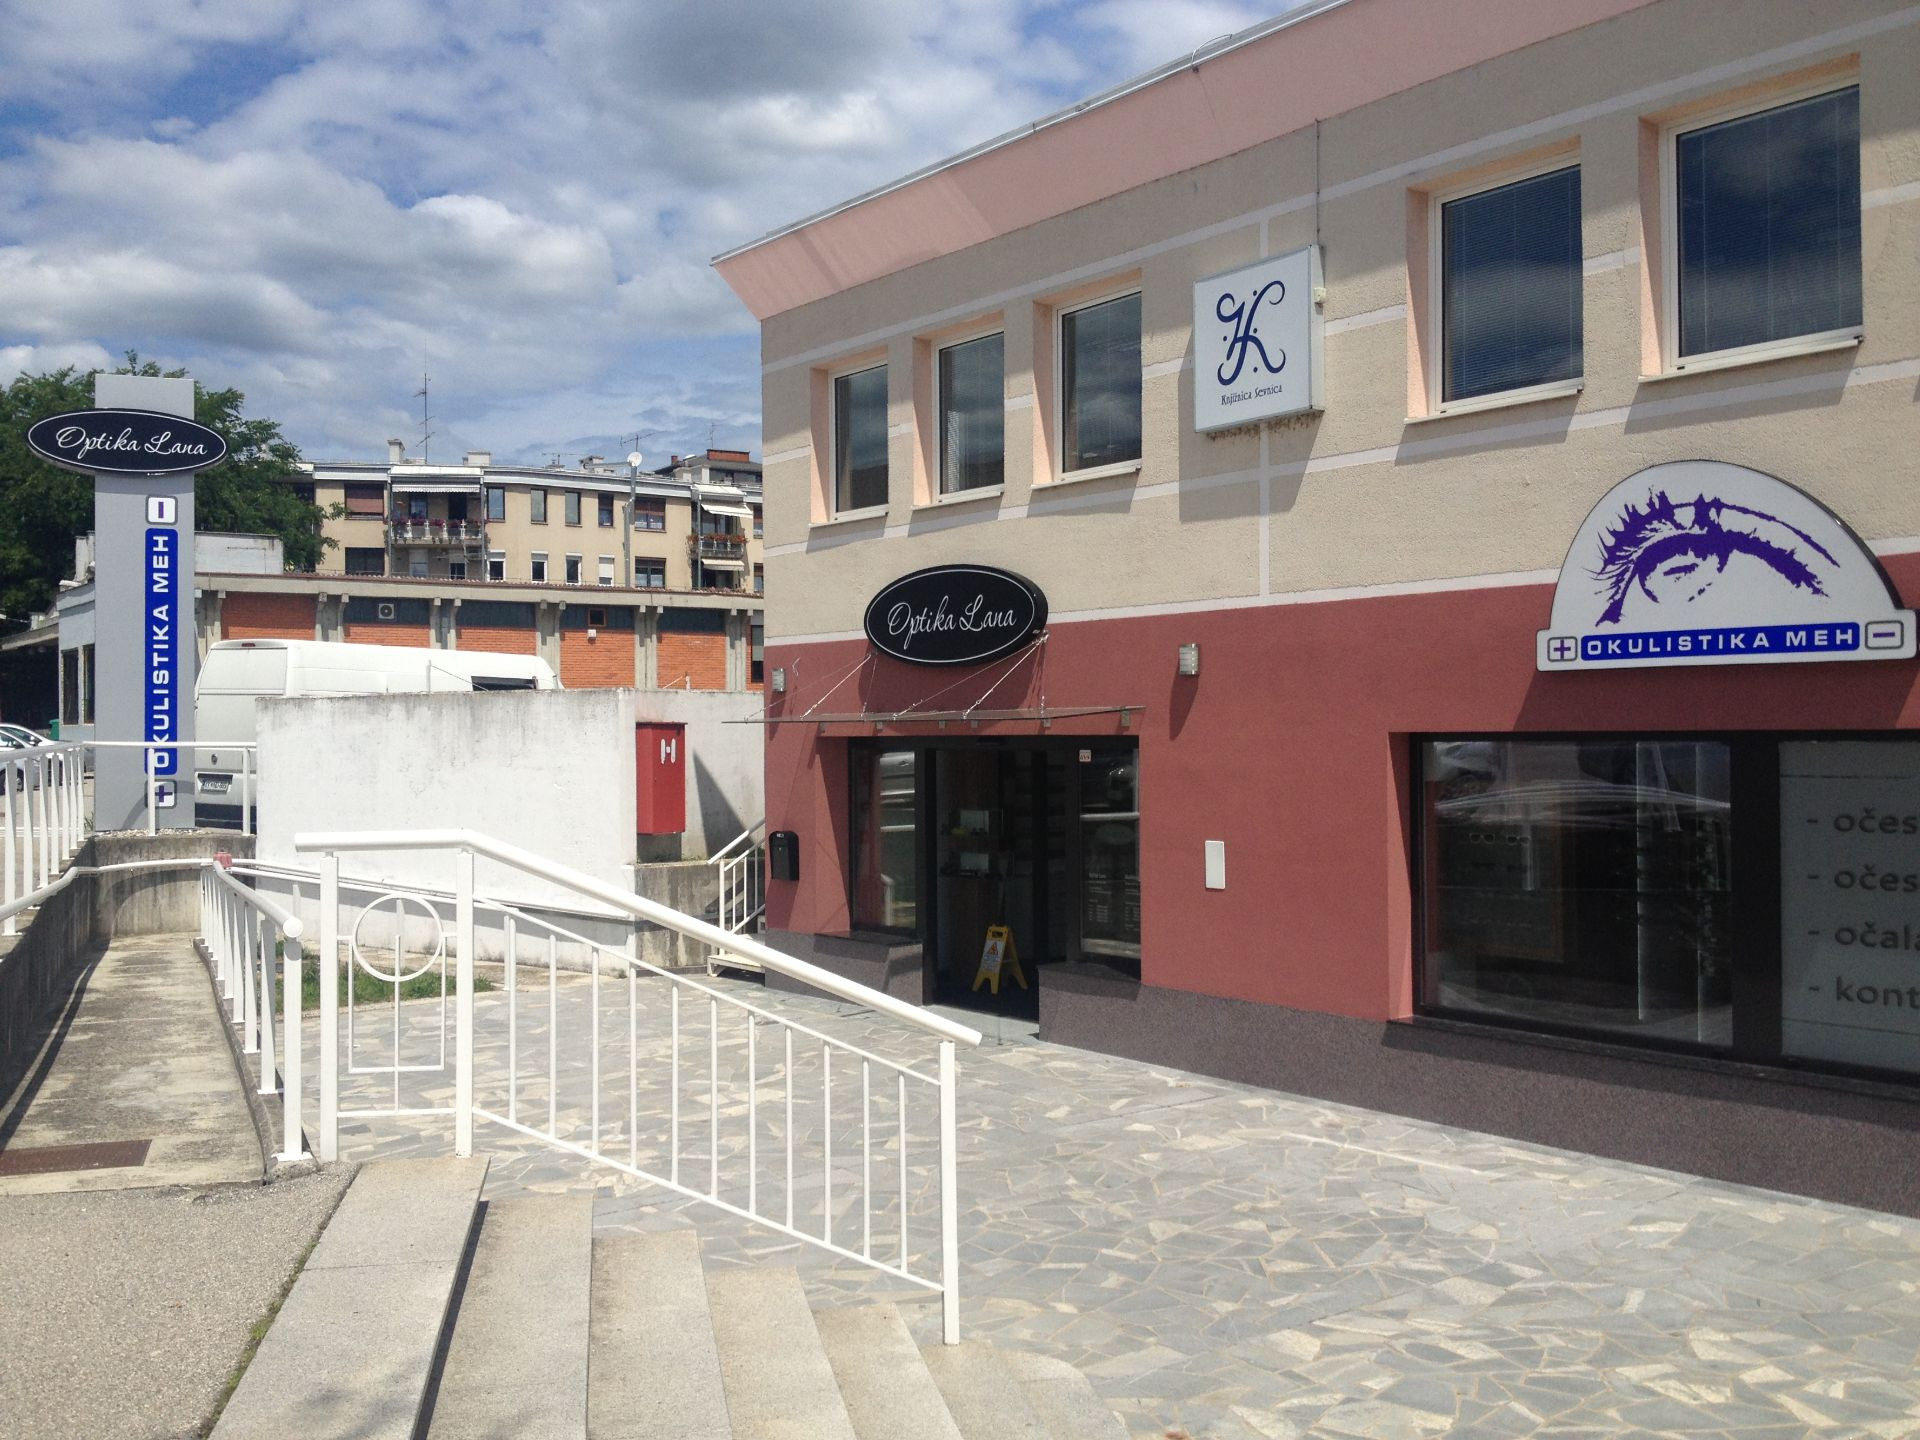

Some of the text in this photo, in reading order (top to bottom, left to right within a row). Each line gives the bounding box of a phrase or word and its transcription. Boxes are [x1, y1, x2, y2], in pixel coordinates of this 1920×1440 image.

[1254, 385, 1283, 399] Sevnica
[55, 426, 208, 460] Optika Lana
[887, 594, 1017, 650] Optika Lana
[152, 535, 170, 768] OKULISTIKA MEH
[1587, 628, 1853, 656] OKULISTIKA MEH
[1834, 864, 1920, 892] očes
